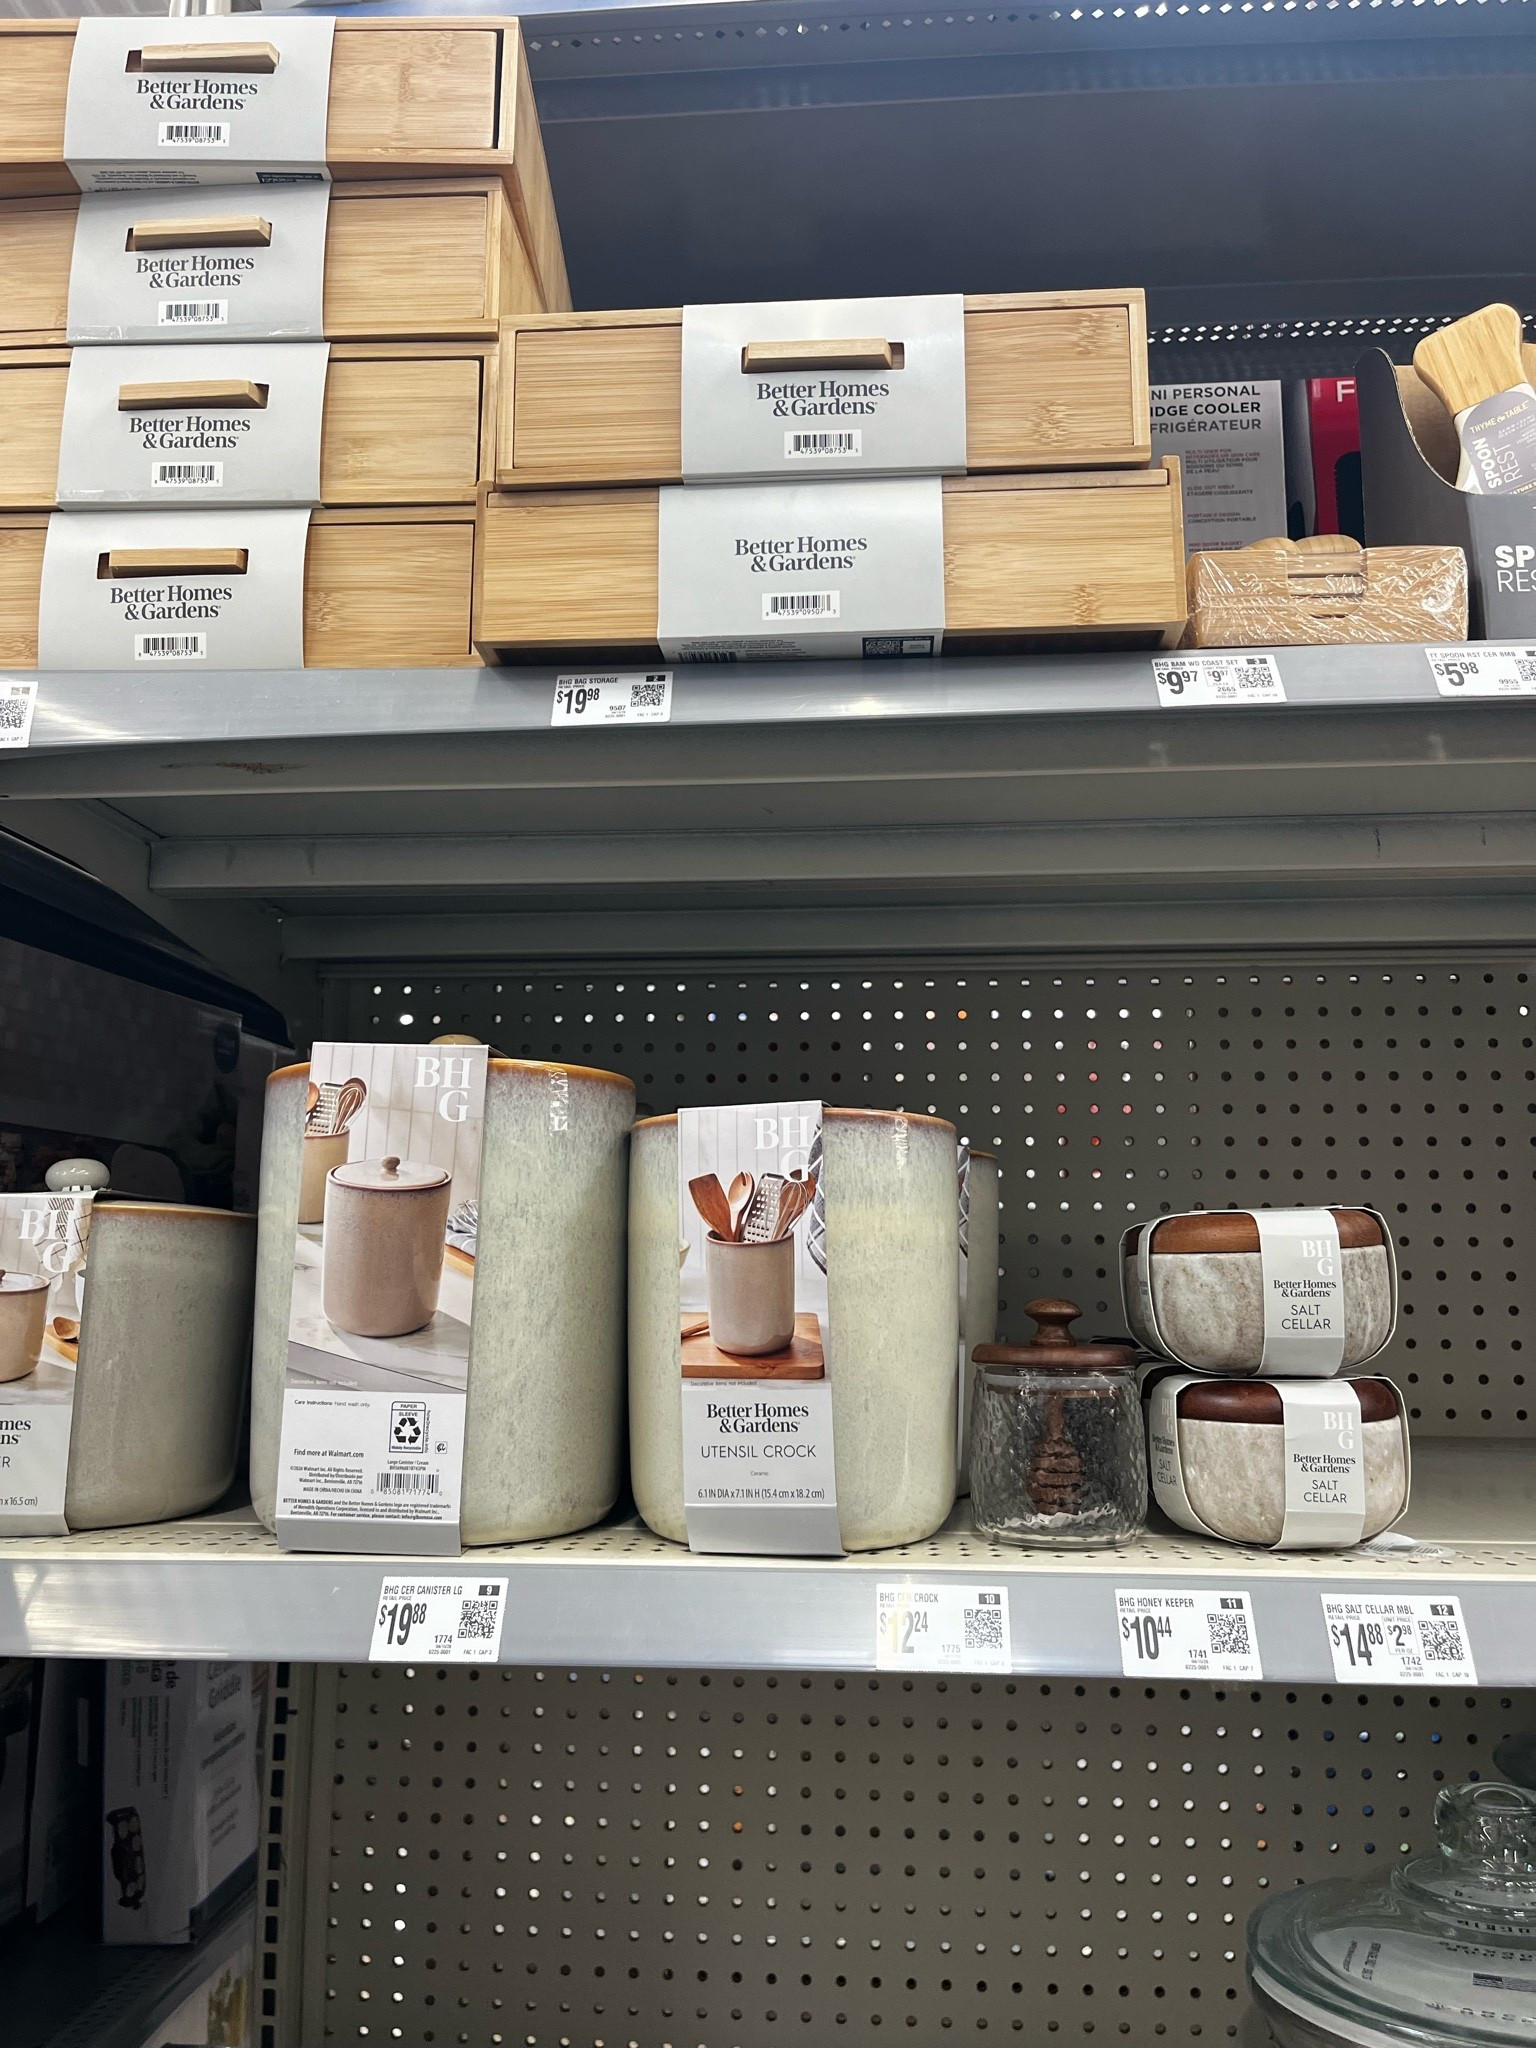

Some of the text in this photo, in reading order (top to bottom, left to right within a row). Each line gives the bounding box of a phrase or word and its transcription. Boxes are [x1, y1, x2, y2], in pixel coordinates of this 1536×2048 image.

[137, 79, 257, 94] Better Homes
[136, 255, 254, 273] Better Homes
[757, 381, 889, 399] Better Homes
[1152, 385, 1260, 400] NI PERSONAL
[1337, 381, 1354, 402] F
[1194, 402, 1260, 414] COOLER
[1470, 418, 1496, 433] THYME
[1505, 400, 1529, 417] TABLE
[129, 416, 250, 432] Better Homes
[1151, 419, 1261, 433] FRIGÉRATEUR
[1472, 438, 1502, 488] SPOON
[1493, 444, 1523, 483] REST
[735, 536, 867, 555] Better Homes
[1495, 545, 1535, 568] SP
[111, 585, 232, 603] Better Homes
[414, 1057, 473, 1088] BH
[439, 1090, 470, 1122] G
[754, 1116, 810, 1149] BH
[781, 1150, 810, 1182] G
[1302, 1240, 1333, 1257] BH
[43, 1242, 70, 1273] G
[1318, 1258, 1333, 1276] G
[1274, 1280, 1336, 1289] Better Homes
[1291, 1305, 1320, 1315] SALT
[1282, 1319, 1331, 1330] CELLAR
[707, 1403, 808, 1418] Better Homes
[0, 1420, 31, 1430] mes
[1323, 1412, 1353, 1430] BH
[0, 1434, 19, 1444] ns
[1338, 1431, 1353, 1449] G
[701, 1445, 816, 1458] UTENSIL CROCK
[1160, 1458, 1170, 1471] SALT
[1294, 1454, 1355, 1465] Better Homes
[1157, 1472, 1177, 1486] CELLAR
[1312, 1480, 1338, 1490] SALT
[698, 1489, 708, 1498] 6.1
[709, 1489, 716, 1498] IN
[717, 1489, 729, 1498] DIA
[736, 1489, 745, 1498] 7.1
[746, 1489, 753, 1498] IN
[755, 1489, 760, 1498] H
[762, 1489, 777, 1499] (15.4
[796, 1489, 810, 1498] 18.2
[812, 1489, 824, 1499] cm)
[1304, 1493, 1347, 1503] CELLAR
[384, 1586, 462, 1594] BHG CER CANISTER LG
[486, 1585, 492, 1595] 9
[880, 1593, 894, 1601] BHG
[914, 1594, 938, 1602] CROCK
[985, 1595, 995, 1603] 10
[1120, 1598, 1194, 1607] BHG HONEY KEEPER
[1226, 1599, 1237, 1608] 11
[1327, 1604, 1414, 1614] BHG SALT CELLAR MBL
[1437, 1605, 1449, 1615] 12
[434, 1635, 452, 1643] 1774
[1188, 1650, 1207, 1658] 1741
[1401, 1657, 1421, 1665] 1742
